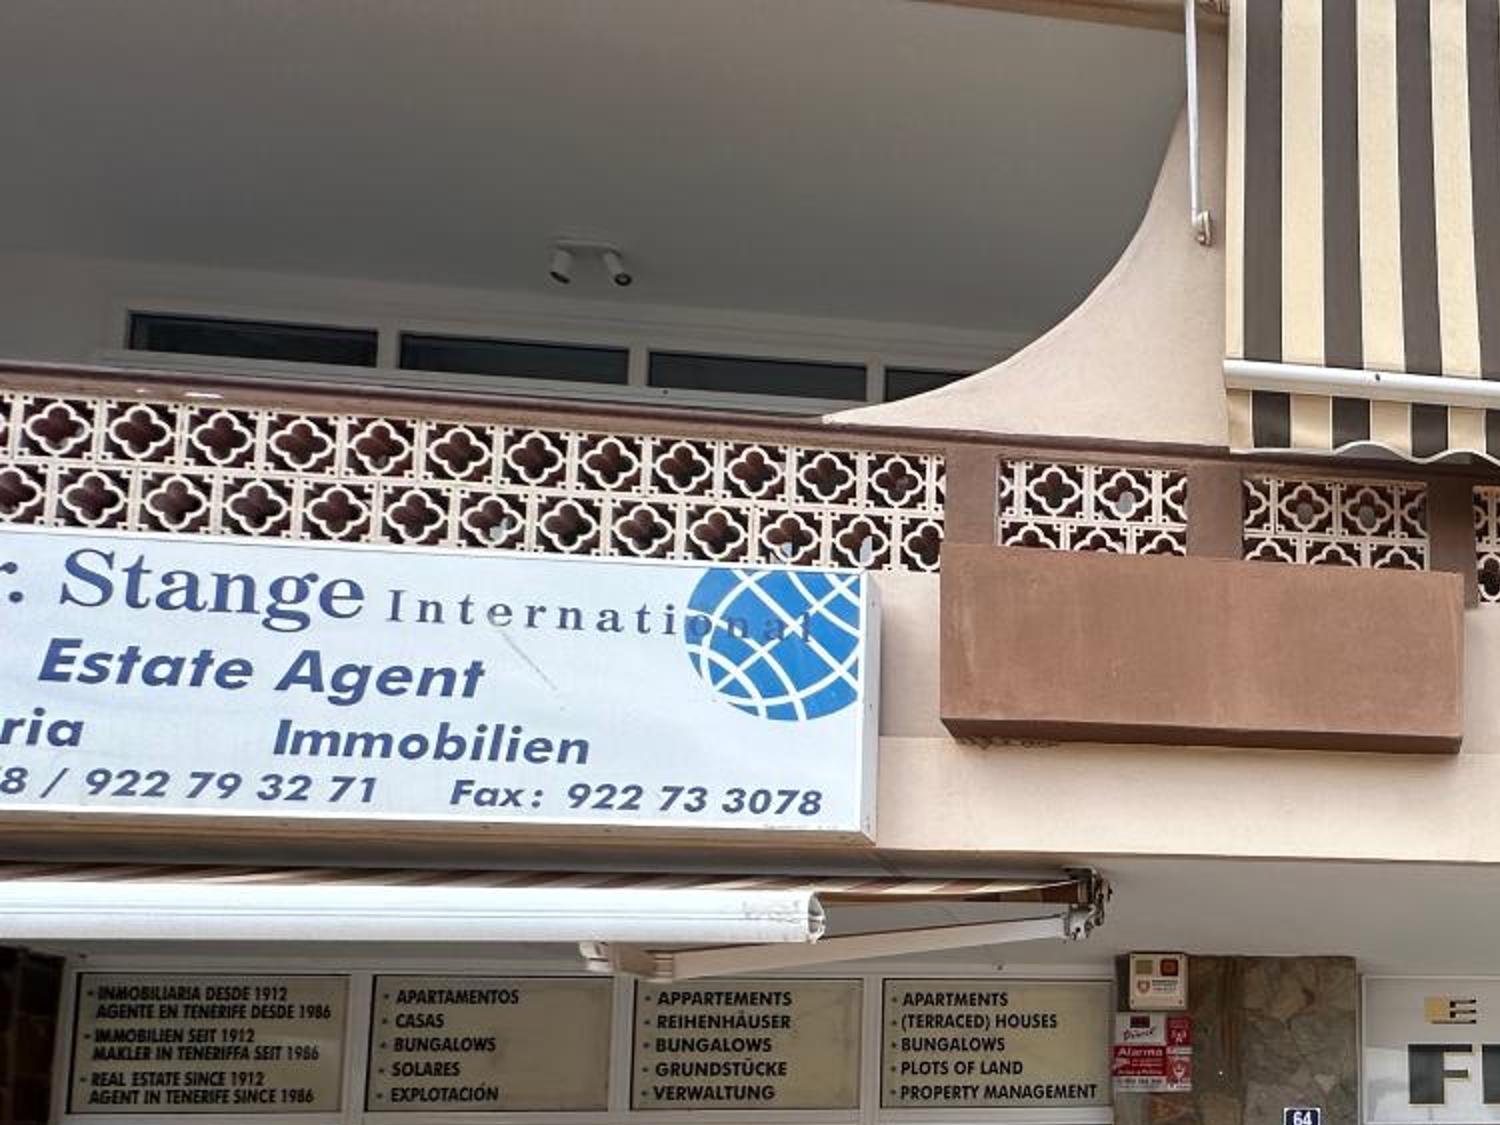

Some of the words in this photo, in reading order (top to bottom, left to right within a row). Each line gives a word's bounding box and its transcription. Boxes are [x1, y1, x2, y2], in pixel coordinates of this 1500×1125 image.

[60, 548, 365, 633] Stange
[386, 590, 812, 642] International
[38, 638, 253, 690] Estate
[274, 649, 485, 706] Agent
[273, 719, 590, 764] Immobilien
[85, 768, 170, 797] 922
[186, 772, 242, 799] 79
[257, 773, 312, 801] 32
[328, 776, 376, 803] 71
[567, 783, 643, 810] 922
[659, 786, 708, 812] 73
[722, 788, 822, 816] 3078
[97, 985, 200, 1001] INMOBILIARIA
[205, 985, 249, 1001] DESDE
[255, 986, 288, 1001] 1912
[396, 989, 520, 1005] APARTAMENTOS
[657, 991, 792, 1006] APPARTEMENTS
[902, 992, 1009, 1007] APARTMENTS
[96, 1004, 151, 1019] AGENTE
[159, 1004, 177, 1019] EN
[183, 1004, 247, 1019] TENERIFE
[252, 1004, 295, 1019] DESDE
[300, 1004, 331, 1018] 1986
[656, 1009, 791, 1029] REIHENHÄUSER
[395, 1013, 445, 1028] CASAS
[901, 1013, 991, 1032] (TERRACED)
[995, 1013, 1057, 1028] HOUSES
[94, 1028, 183, 1043] IMMOBILIEN
[189, 1028, 217, 1043] SEIT
[222, 1028, 255, 1043] 1912
[393, 1037, 496, 1052] BUNGALOWS
[655, 1037, 772, 1052] BUNGALOWS
[901, 1037, 1005, 1052] BUNGALOWS
[92, 1047, 151, 1061] MAKLER
[156, 1047, 172, 1061] IN
[178, 1047, 249, 1061] TENERIFFA
[254, 1047, 281, 1061] SEIT
[287, 1046, 319, 1061] 1986
[391, 1061, 460, 1077] SOLARES
[655, 1057, 787, 1077] GRUNDSTÜCKE
[901, 1061, 948, 1075] PLOTS
[953, 1061, 975, 1075] OF
[980, 1061, 1023, 1075] LAND
[91, 1072, 126, 1087] REAL
[132, 1072, 180, 1087] ESTATE
[184, 1072, 226, 1087] SINCE
[231, 1072, 264, 1087] 1912
[88, 1090, 139, 1105] AGENT
[144, 1090, 161, 1104] IN
[165, 1089, 230, 1104] TENERIFE
[234, 1089, 276, 1104] SINCE
[281, 1089, 314, 1103] 1986
[390, 1082, 499, 1102] EXPLOTACIÓN
[652, 1085, 776, 1101] VERWALTUNG
[901, 1085, 979, 1100] PROPERTY
[983, 1084, 1098, 1100] MANAGEMENT
